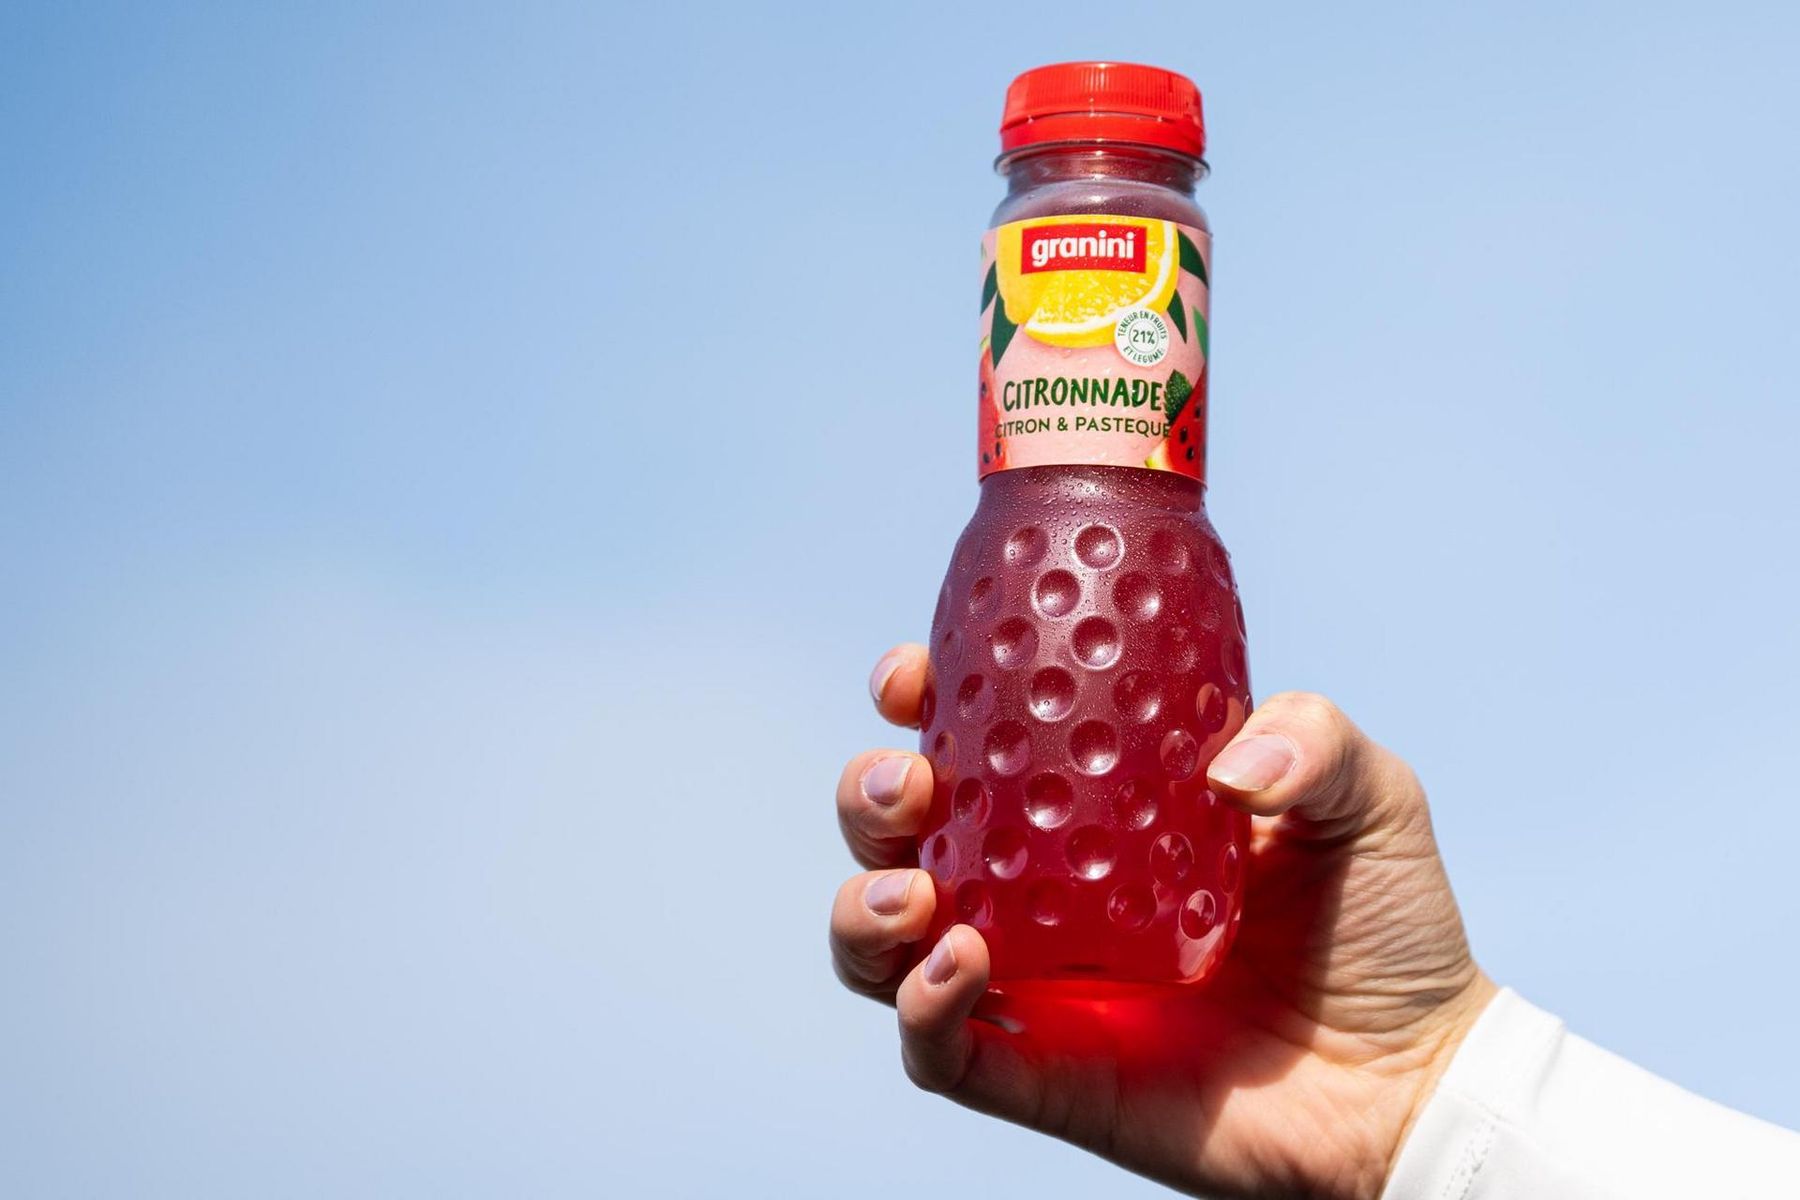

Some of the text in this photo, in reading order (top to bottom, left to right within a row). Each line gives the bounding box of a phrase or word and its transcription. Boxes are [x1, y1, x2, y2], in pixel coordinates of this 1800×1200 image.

[1031, 229, 1136, 268] granini
[1117, 310, 1167, 340] TENEUR EN FRUITS
[1132, 329, 1155, 345] 21%
[1123, 345, 1134, 356] ET
[994, 416, 1172, 439] CITRON & PASTEQUE
